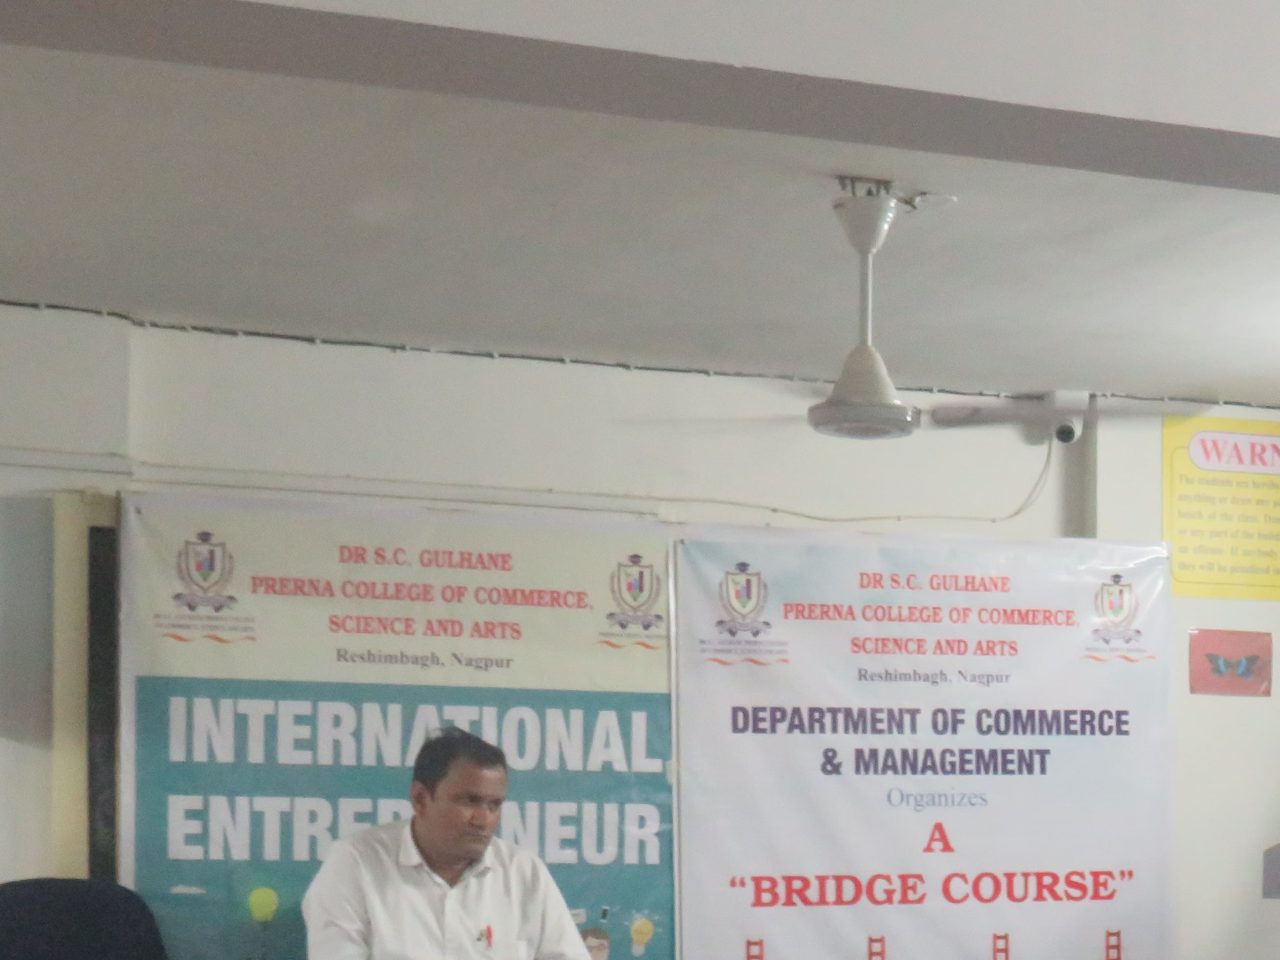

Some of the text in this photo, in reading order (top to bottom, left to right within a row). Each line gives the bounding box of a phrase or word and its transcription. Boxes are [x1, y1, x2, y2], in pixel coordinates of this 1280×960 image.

[338, 545, 367, 564] DR
[419, 549, 512, 571] GULHANE
[251, 576, 336, 597] PRERNA
[341, 580, 435, 602] COLLEGE
[440, 585, 468, 603] OF
[858, 572, 884, 589] DR
[928, 573, 1011, 593] GULHANE
[783, 603, 856, 621] PRERNA
[861, 605, 942, 623] COLLEGE
[948, 607, 972, 624] OF
[328, 614, 522, 640] SCIENCE AND ARTS
[850, 637, 1019, 656] SCIENCE AND ARTS
[336, 648, 513, 672] Reshimbagh, Nagpur
[957, 669, 1011, 687] Nagpur
[731, 706, 1131, 736] DEPARTMENT OF COMMERCE
[820, 748, 1051, 776] & MANAGEMENT
[886, 787, 988, 813] Organizes
[922, 821, 955, 853] A
